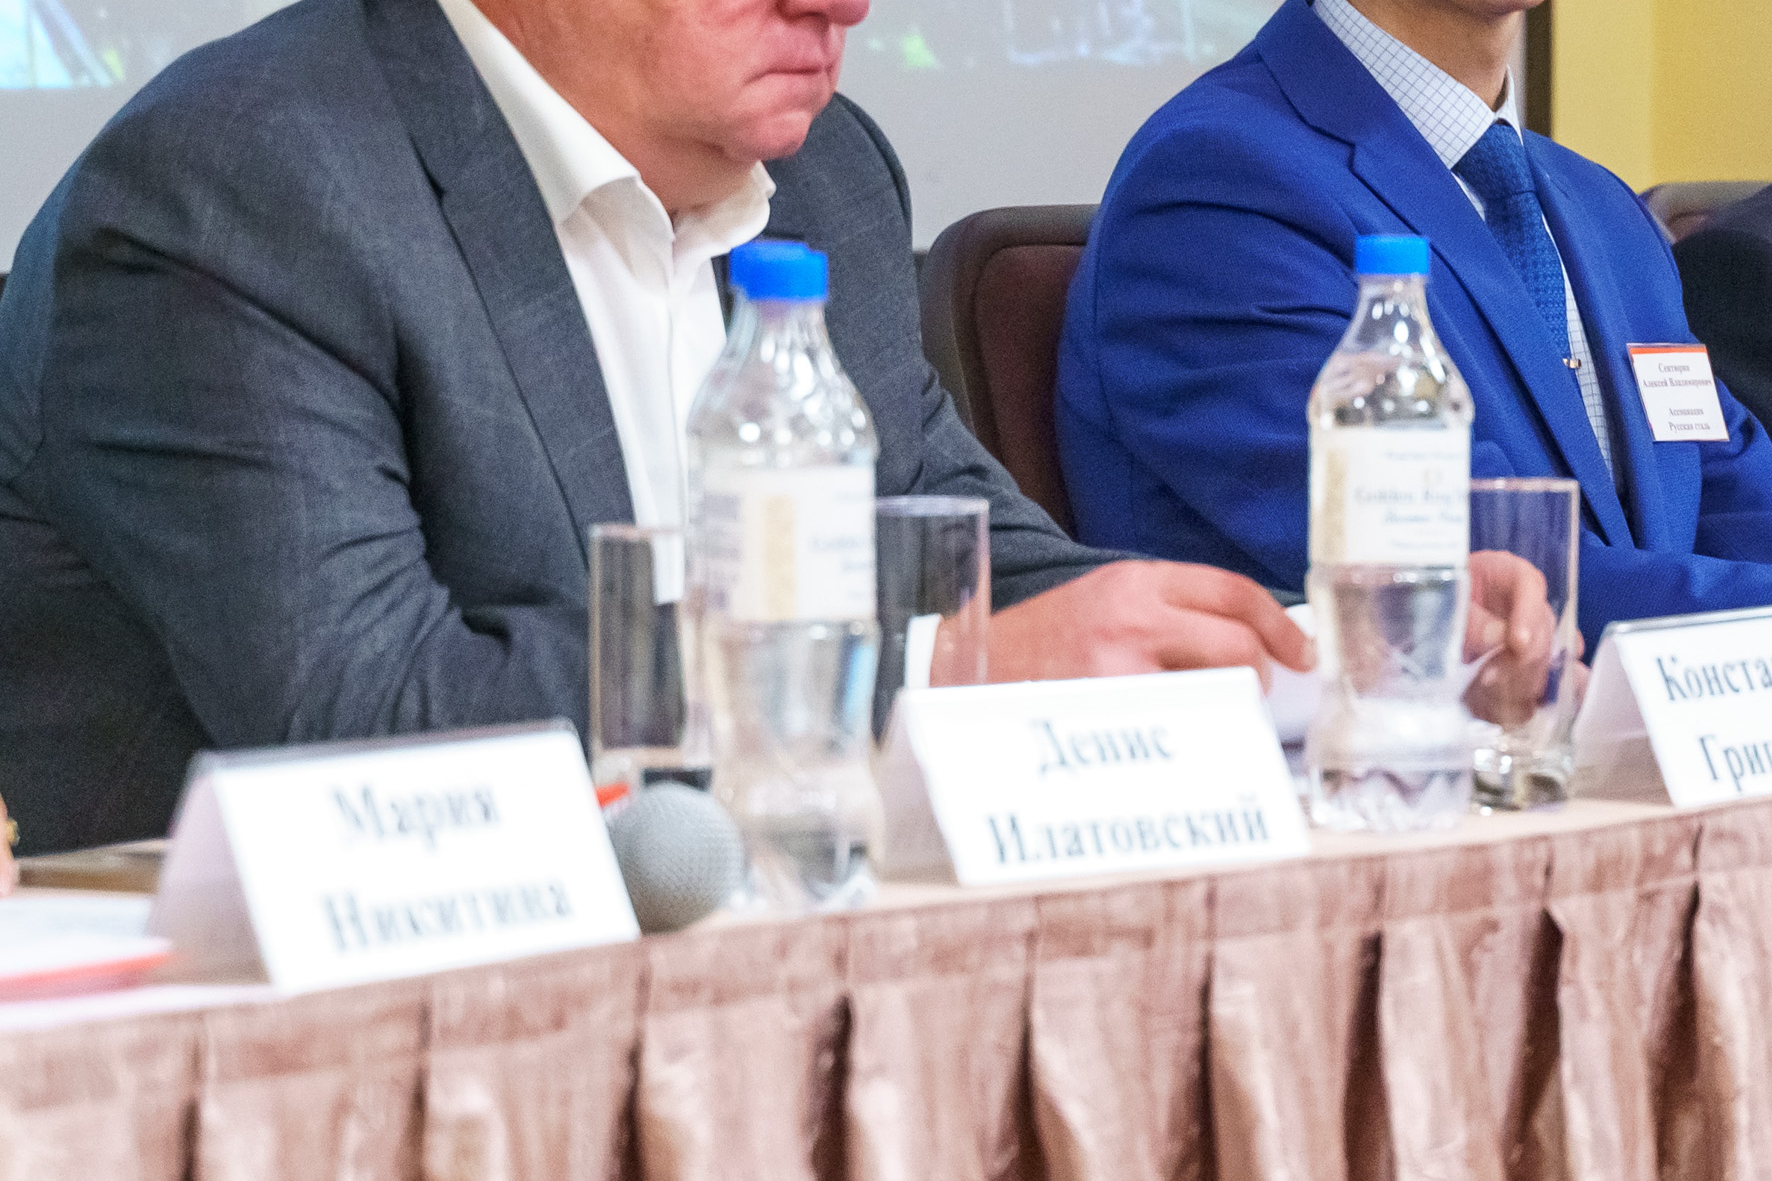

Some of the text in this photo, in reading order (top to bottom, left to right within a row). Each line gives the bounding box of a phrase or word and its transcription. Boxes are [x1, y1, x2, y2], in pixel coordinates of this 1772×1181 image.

[1029, 719, 1174, 776] Денис
[332, 782, 502, 850] Мария
[322, 880, 575, 954] Никитина
